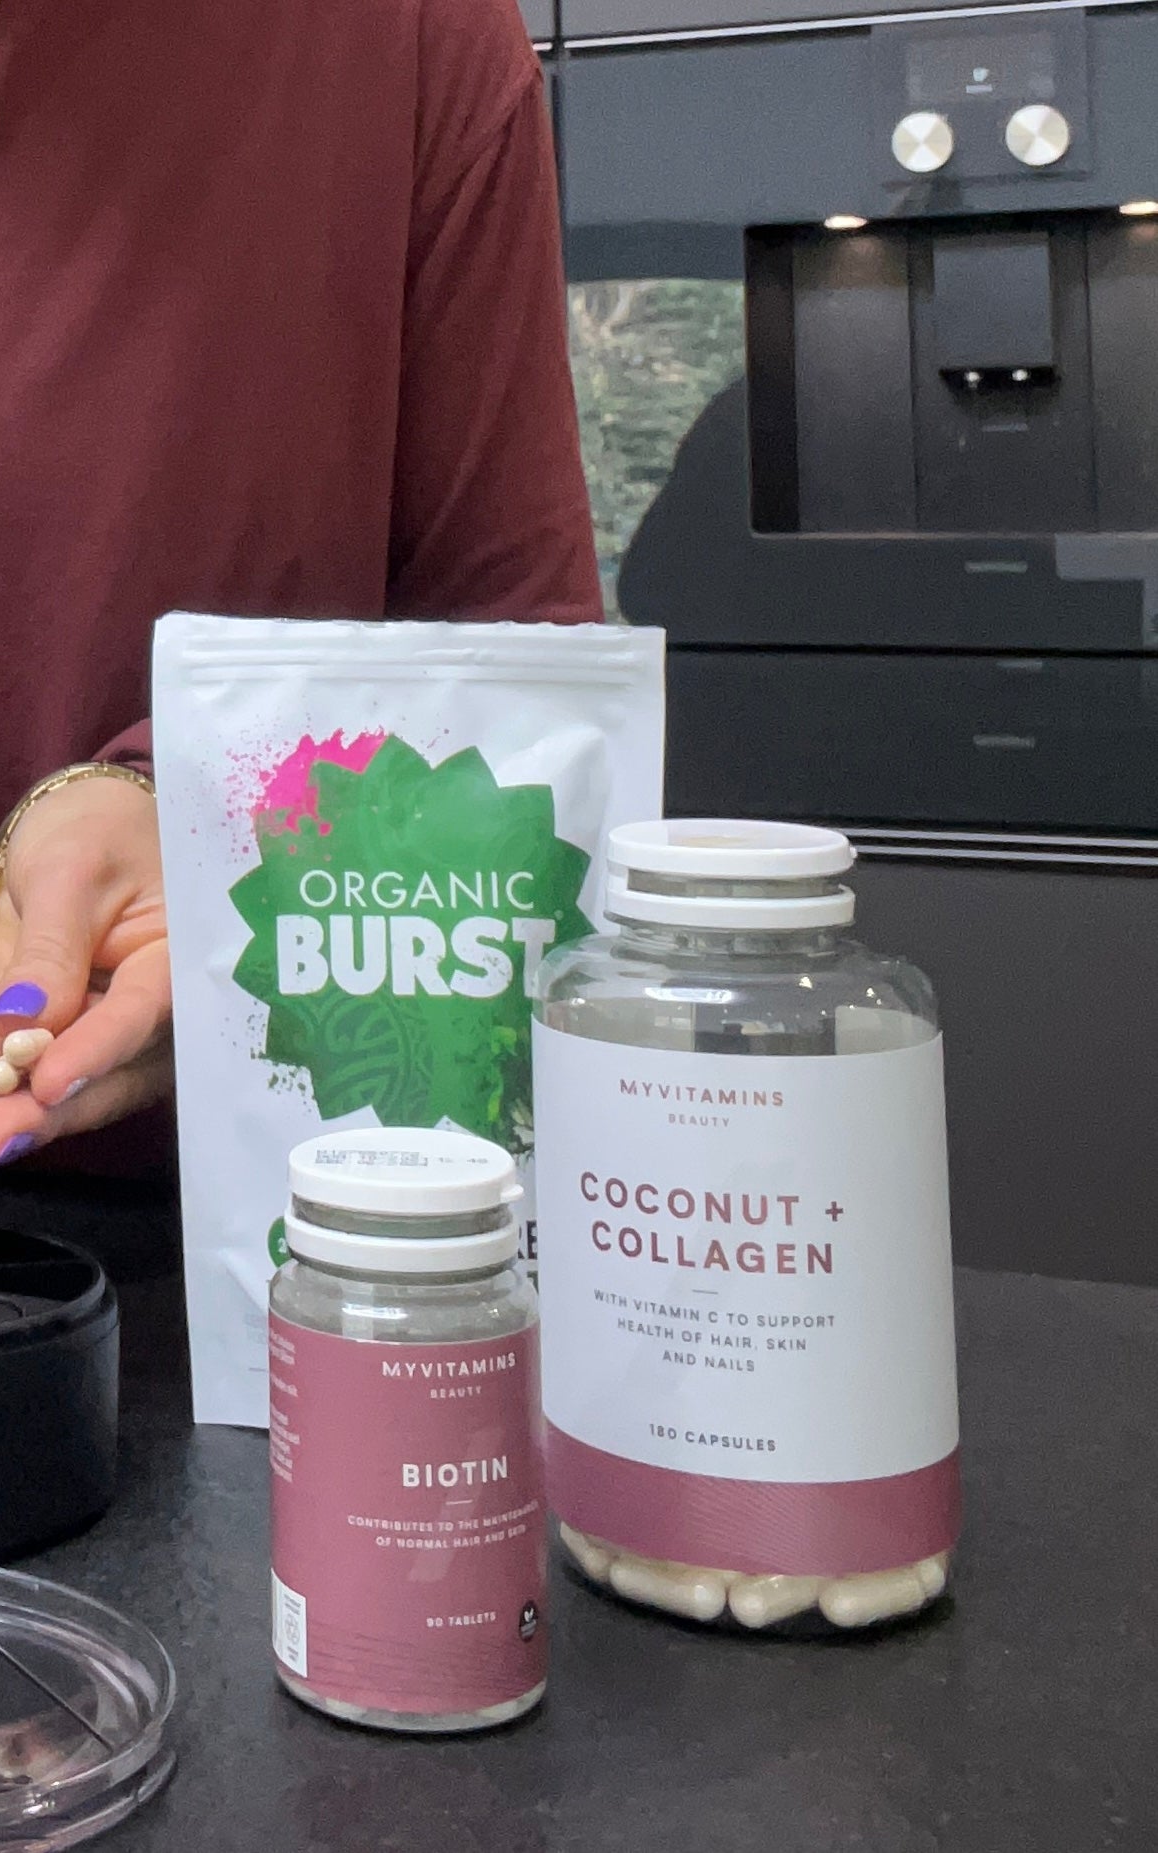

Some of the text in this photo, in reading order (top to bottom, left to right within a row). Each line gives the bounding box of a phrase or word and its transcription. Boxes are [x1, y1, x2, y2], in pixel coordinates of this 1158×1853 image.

[299, 869, 534, 911] ORGANIC
[276, 914, 556, 998] BURST
[620, 1078, 784, 1107] MYVITAMINS
[668, 1112, 731, 1128] BEAUTY
[581, 1171, 844, 1226] COCONUT +
[591, 1220, 833, 1274] COLLAGEN
[593, 1288, 836, 1328] WITH VITAMIN C TO SUPPORT
[617, 1318, 674, 1340] HEALTH
[681, 1330, 702, 1344] OF
[766, 1338, 807, 1351] SKIN
[382, 1352, 516, 1379] MYVITAMINS
[662, 1350, 755, 1372] AND NAILS
[430, 1385, 482, 1399] BEAUTY
[649, 1423, 777, 1452] 180 CAPSULES
[402, 1455, 508, 1488] BIOTIN
[347, 1514, 434, 1533] CONTRIBUTES
[438, 1521, 454, 1533] TO
[458, 1518, 479, 1530] THE
[375, 1535, 392, 1547] OF
[396, 1537, 449, 1549] NORMAL
[453, 1535, 481, 1549] HAIR
[484, 1530, 505, 1544] AND
[426, 1611, 497, 1628] 90 TABLETS
